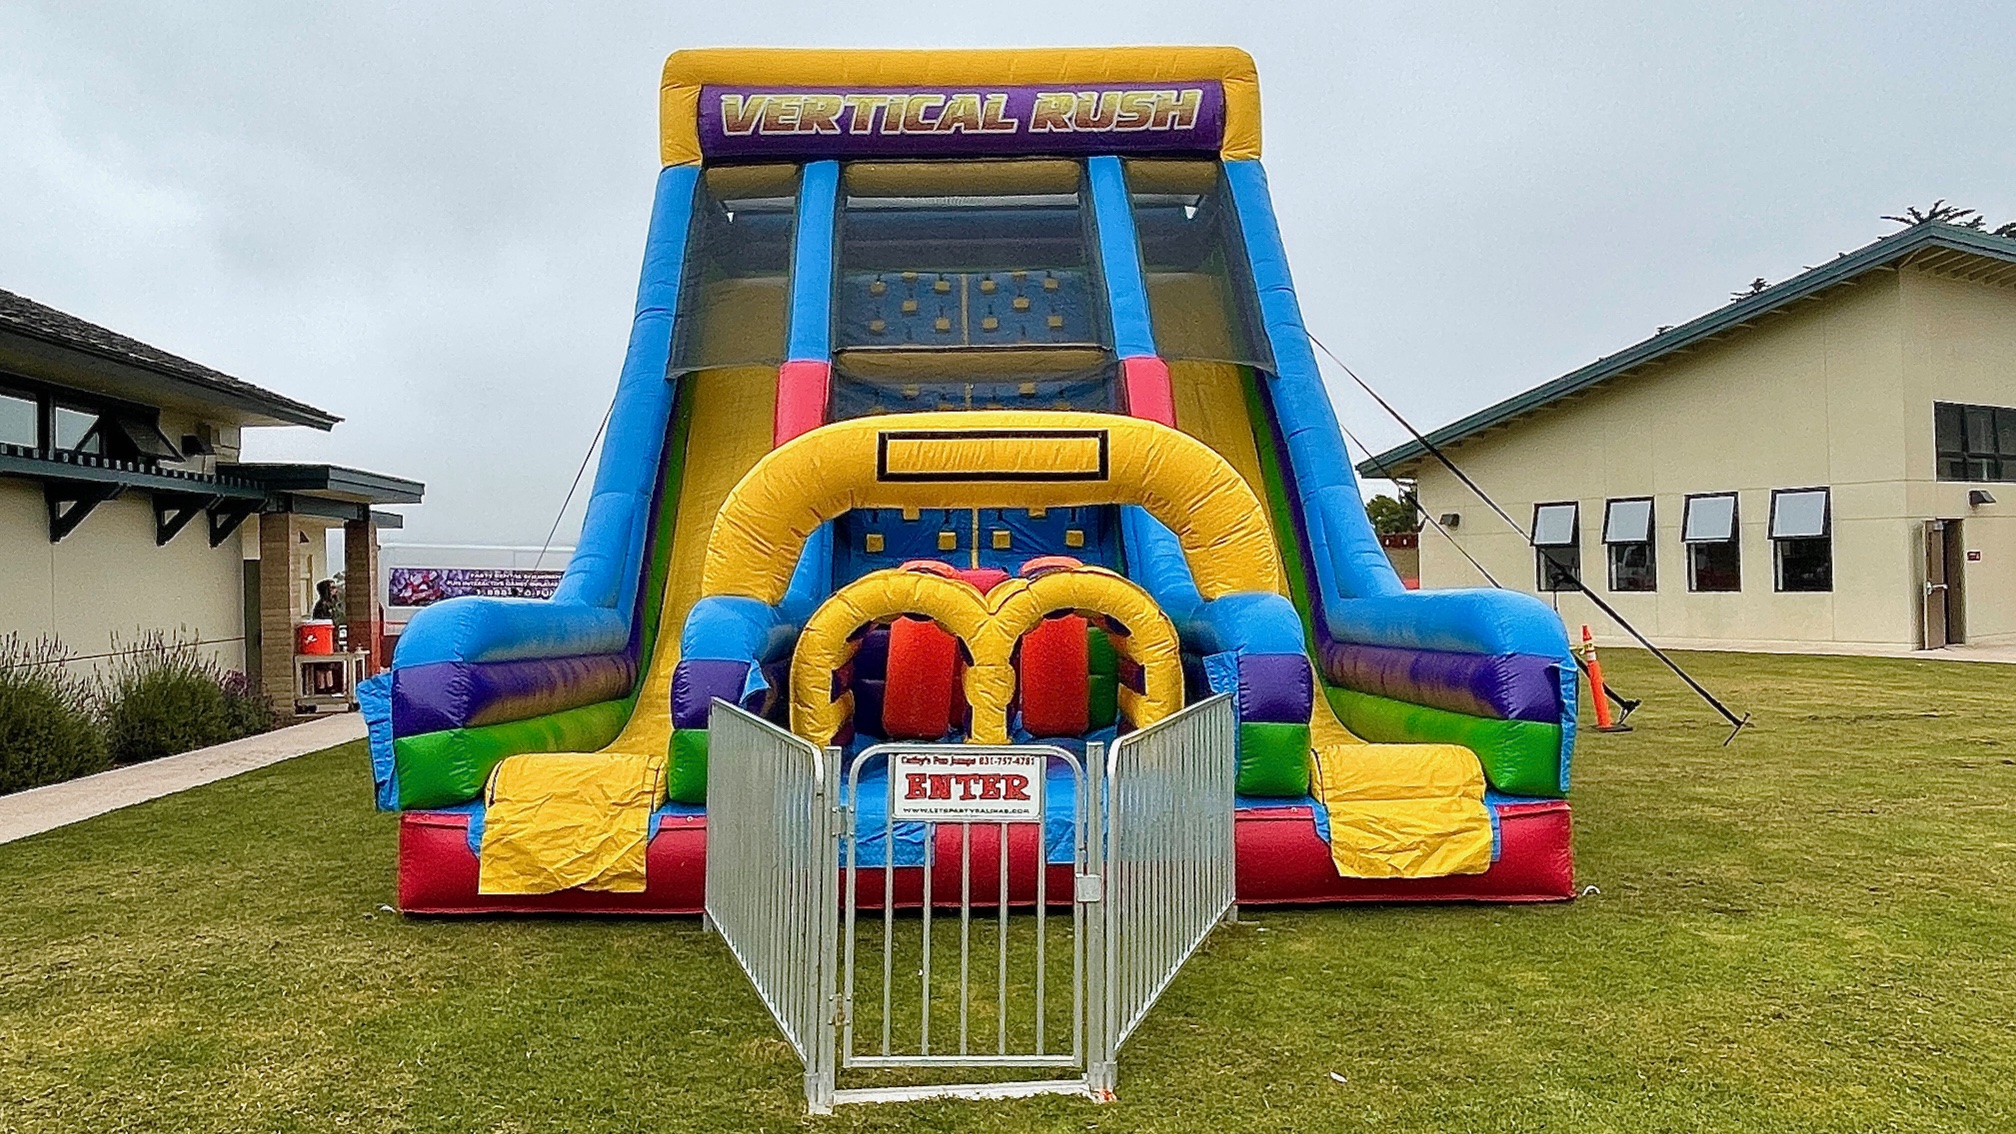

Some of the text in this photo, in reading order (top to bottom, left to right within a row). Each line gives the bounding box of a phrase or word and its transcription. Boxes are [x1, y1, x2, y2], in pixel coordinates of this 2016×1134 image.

[720, 89, 1203, 136] VERTICAL RUSH
[905, 773, 1031, 800] ENTER
